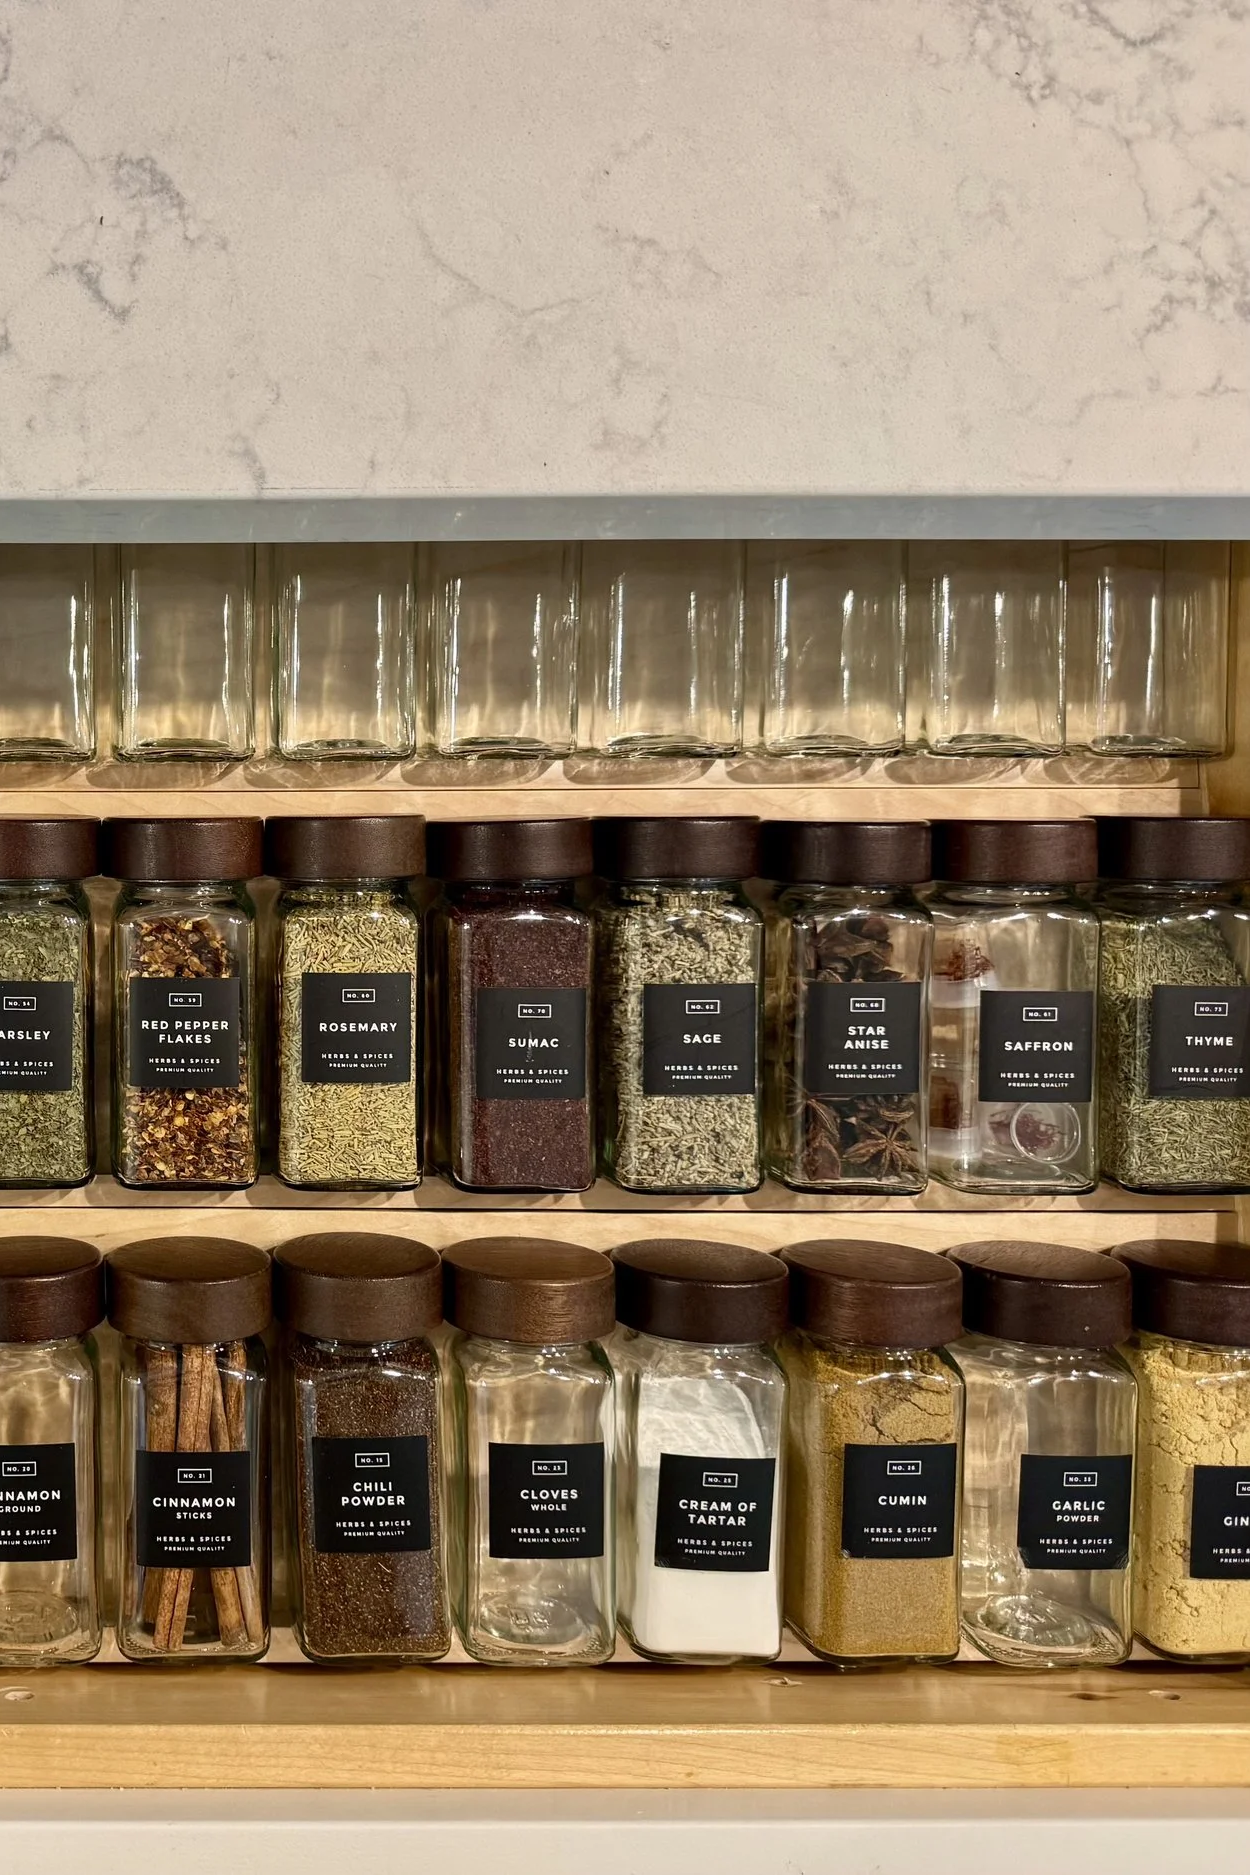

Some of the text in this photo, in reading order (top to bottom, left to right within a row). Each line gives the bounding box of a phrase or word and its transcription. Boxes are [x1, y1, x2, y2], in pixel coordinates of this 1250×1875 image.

[347, 992, 359, 1000] NO.
[691, 1003, 714, 1011] NO. 62
[1200, 1005, 1212, 1013] NO.
[140, 1020, 230, 1030] RED PEPPER
[318, 1022, 398, 1032] ROSEMARY
[847, 1026, 887, 1036] STAR
[158, 1034, 212, 1044] FLAKES
[507, 1038, 560, 1048] SUMAC
[682, 1033, 723, 1044] SAGE
[1184, 1036, 1234, 1046] THYME
[843, 1039, 890, 1049] ANISE
[1003, 1041, 1074, 1052] SAFFRON
[148, 1057, 221, 1065] HERBS & SPICES
[320, 1052, 394, 1060] HERBS & SPICES
[495, 1068, 570, 1076] HERBS & SPICES
[999, 1071, 1076, 1080] HERBS & SPICES
[7, 1465, 30, 1473] NO. 20
[183, 1472, 205, 1480] NO. 21
[352, 1481, 393, 1492] CHILI
[519, 1489, 579, 1500] CLOVES
[151, 1497, 237, 1508] CINNAMON
[340, 1495, 406, 1507] POWDER
[677, 1499, 758, 1512] CREAM OF
[877, 1495, 928, 1506] CUMIN
[1051, 1500, 1107, 1511] GARLIC
[529, 1503, 568, 1512] WHOLE
[175, 1512, 213, 1521] STICKS
[687, 1514, 747, 1526] TARTAR
[1055, 1515, 1100, 1524] POWDER
[334, 1519, 412, 1529] HERBS & SPICES
[15, 1529, 21, 1537] &
[24, 1527, 58, 1537] SPICES
[21, 1538, 51, 1547] QUALITY
[155, 1534, 233, 1544] HERBS & SPICES
[677, 1537, 754, 1548] HERBS & SPICES
[1039, 1537, 1114, 1546] HERBS & SPICES
[163, 1545, 225, 1553] PREMIUM QUALITY
